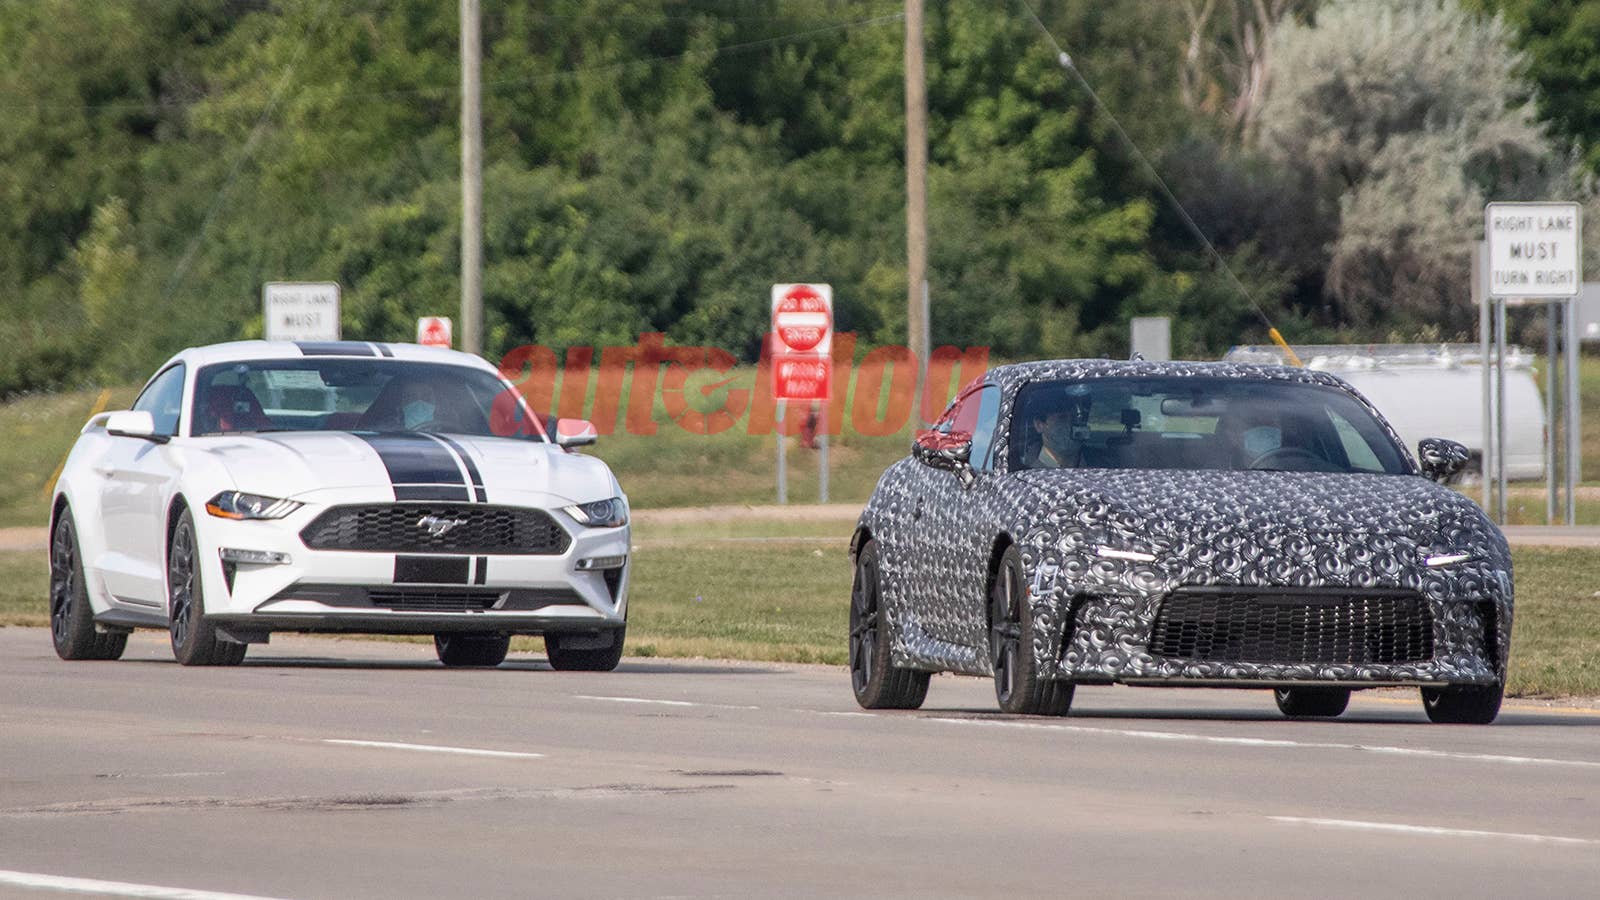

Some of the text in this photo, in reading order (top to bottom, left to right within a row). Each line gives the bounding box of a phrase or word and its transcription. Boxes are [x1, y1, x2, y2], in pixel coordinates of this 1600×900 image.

[1494, 216, 1573, 231] RIGHT LANE
[1510, 241, 1557, 259] MUST
[1494, 270, 1574, 285] TURN RIGHT
[781, 297, 825, 311] DO NOT
[785, 327, 820, 340] ENTER
